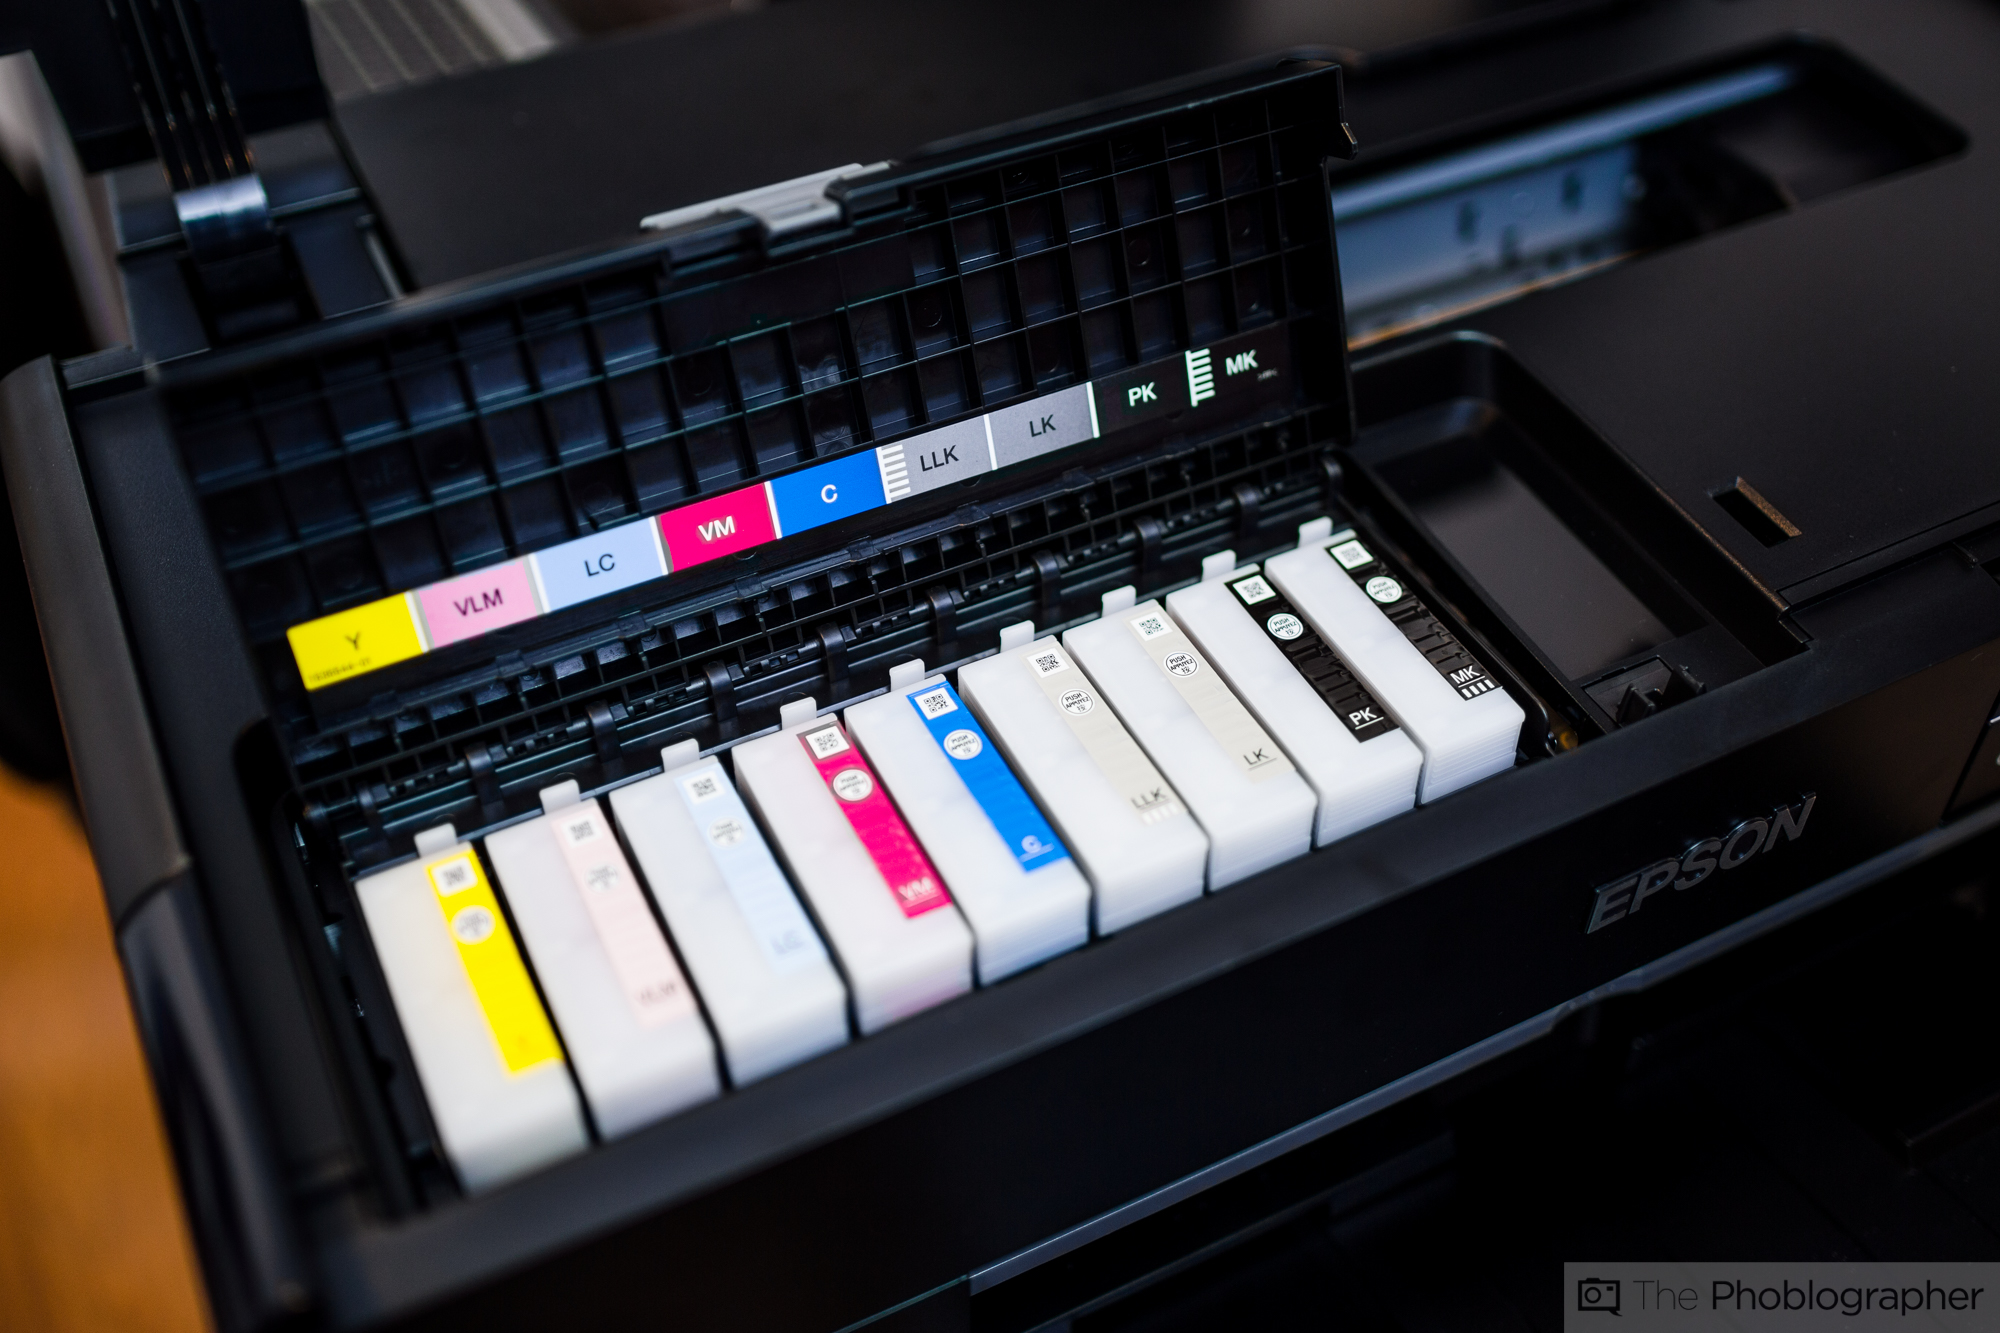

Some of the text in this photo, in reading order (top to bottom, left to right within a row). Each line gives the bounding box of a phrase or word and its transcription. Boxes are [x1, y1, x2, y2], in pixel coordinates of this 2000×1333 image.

[1225, 349, 1259, 376] MK
[1128, 381, 1157, 407] PK
[1029, 414, 1056, 437] LK
[919, 445, 959, 472] LLK
[820, 484, 838, 504] C
[697, 515, 735, 542] VM
[584, 553, 616, 577] LC
[453, 588, 503, 617] VLM
[1273, 617, 1290, 626] PUSH
[344, 630, 361, 652] Y
[1169, 655, 1187, 664] PUSH
[1450, 665, 1481, 686] MK
[1064, 692, 1083, 702] PUSH
[1349, 706, 1378, 726] PK
[1243, 748, 1269, 766] LK
[1130, 787, 1167, 810] LLK
[1020, 835, 1042, 854] C
[1585, 791, 1817, 935] EPSON
[897, 876, 935, 900] VM
